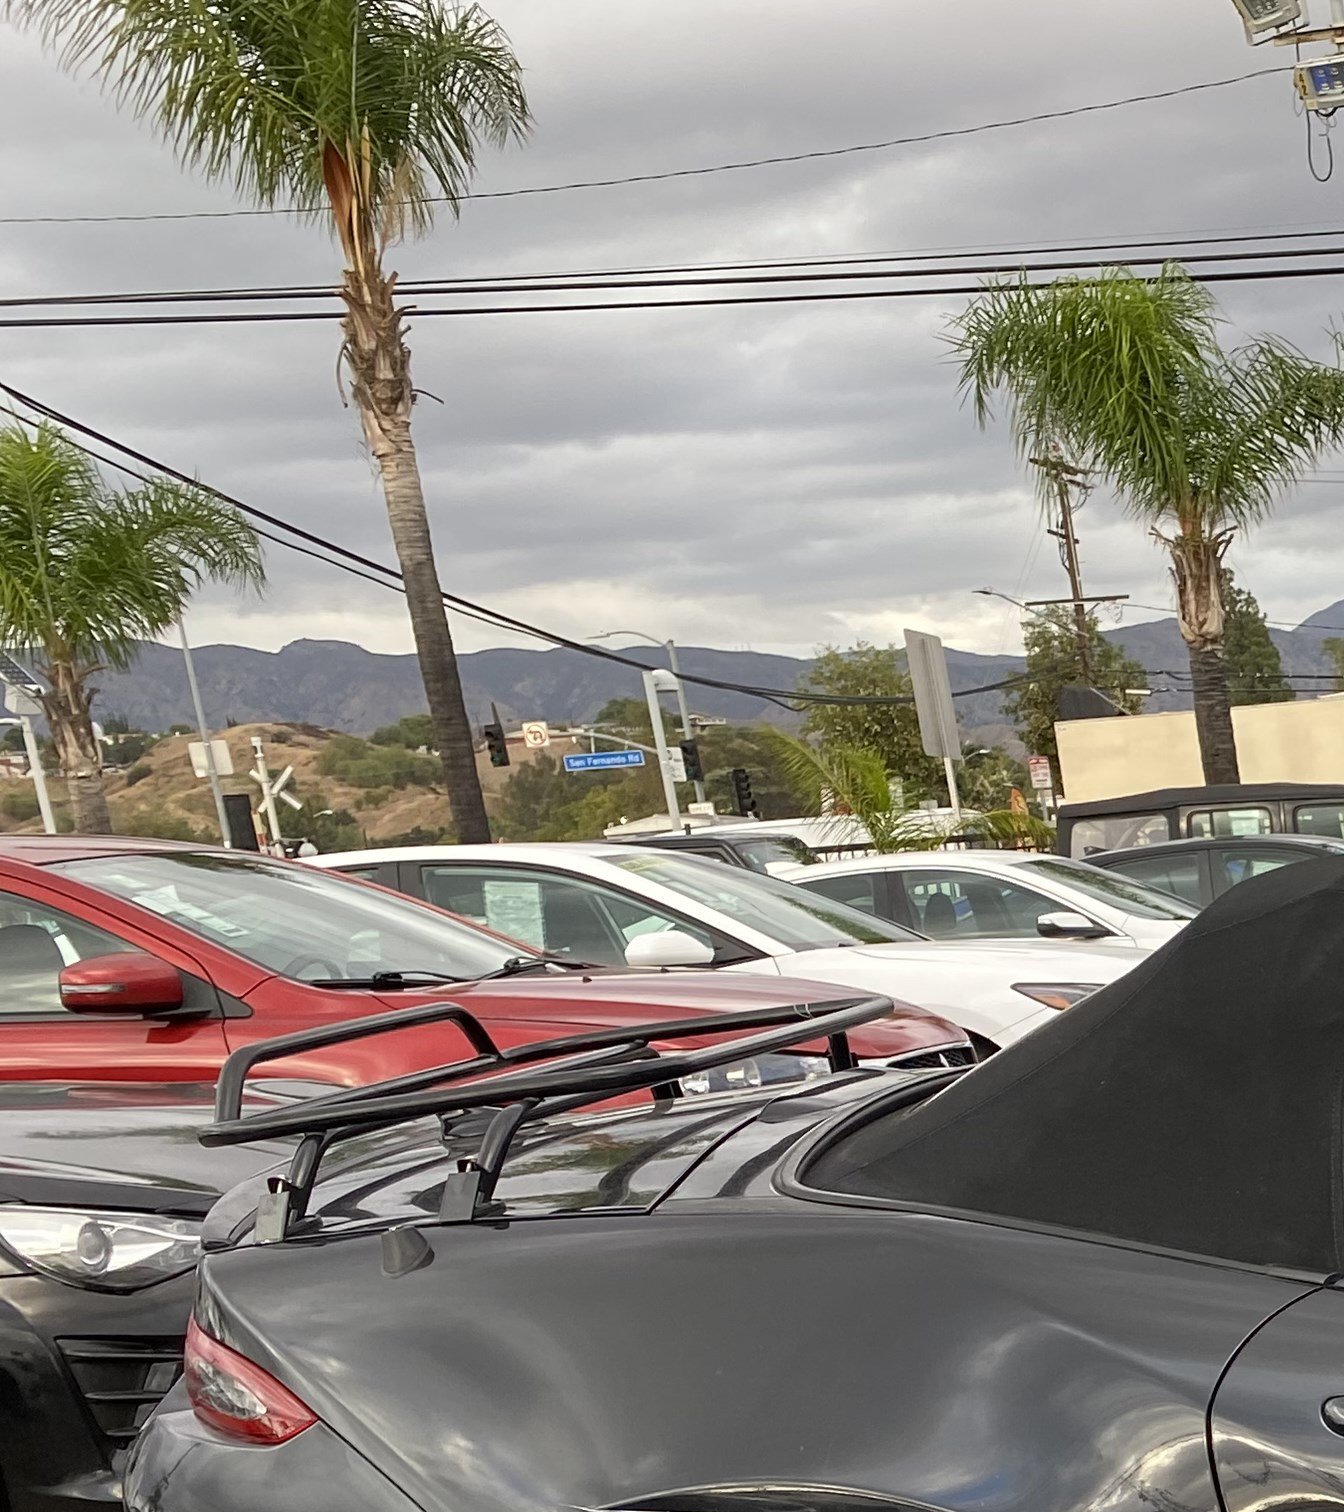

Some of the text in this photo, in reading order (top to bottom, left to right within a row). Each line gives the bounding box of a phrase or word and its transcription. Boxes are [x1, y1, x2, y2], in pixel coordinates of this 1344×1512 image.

[569, 755, 640, 768] San Fernando Rd
